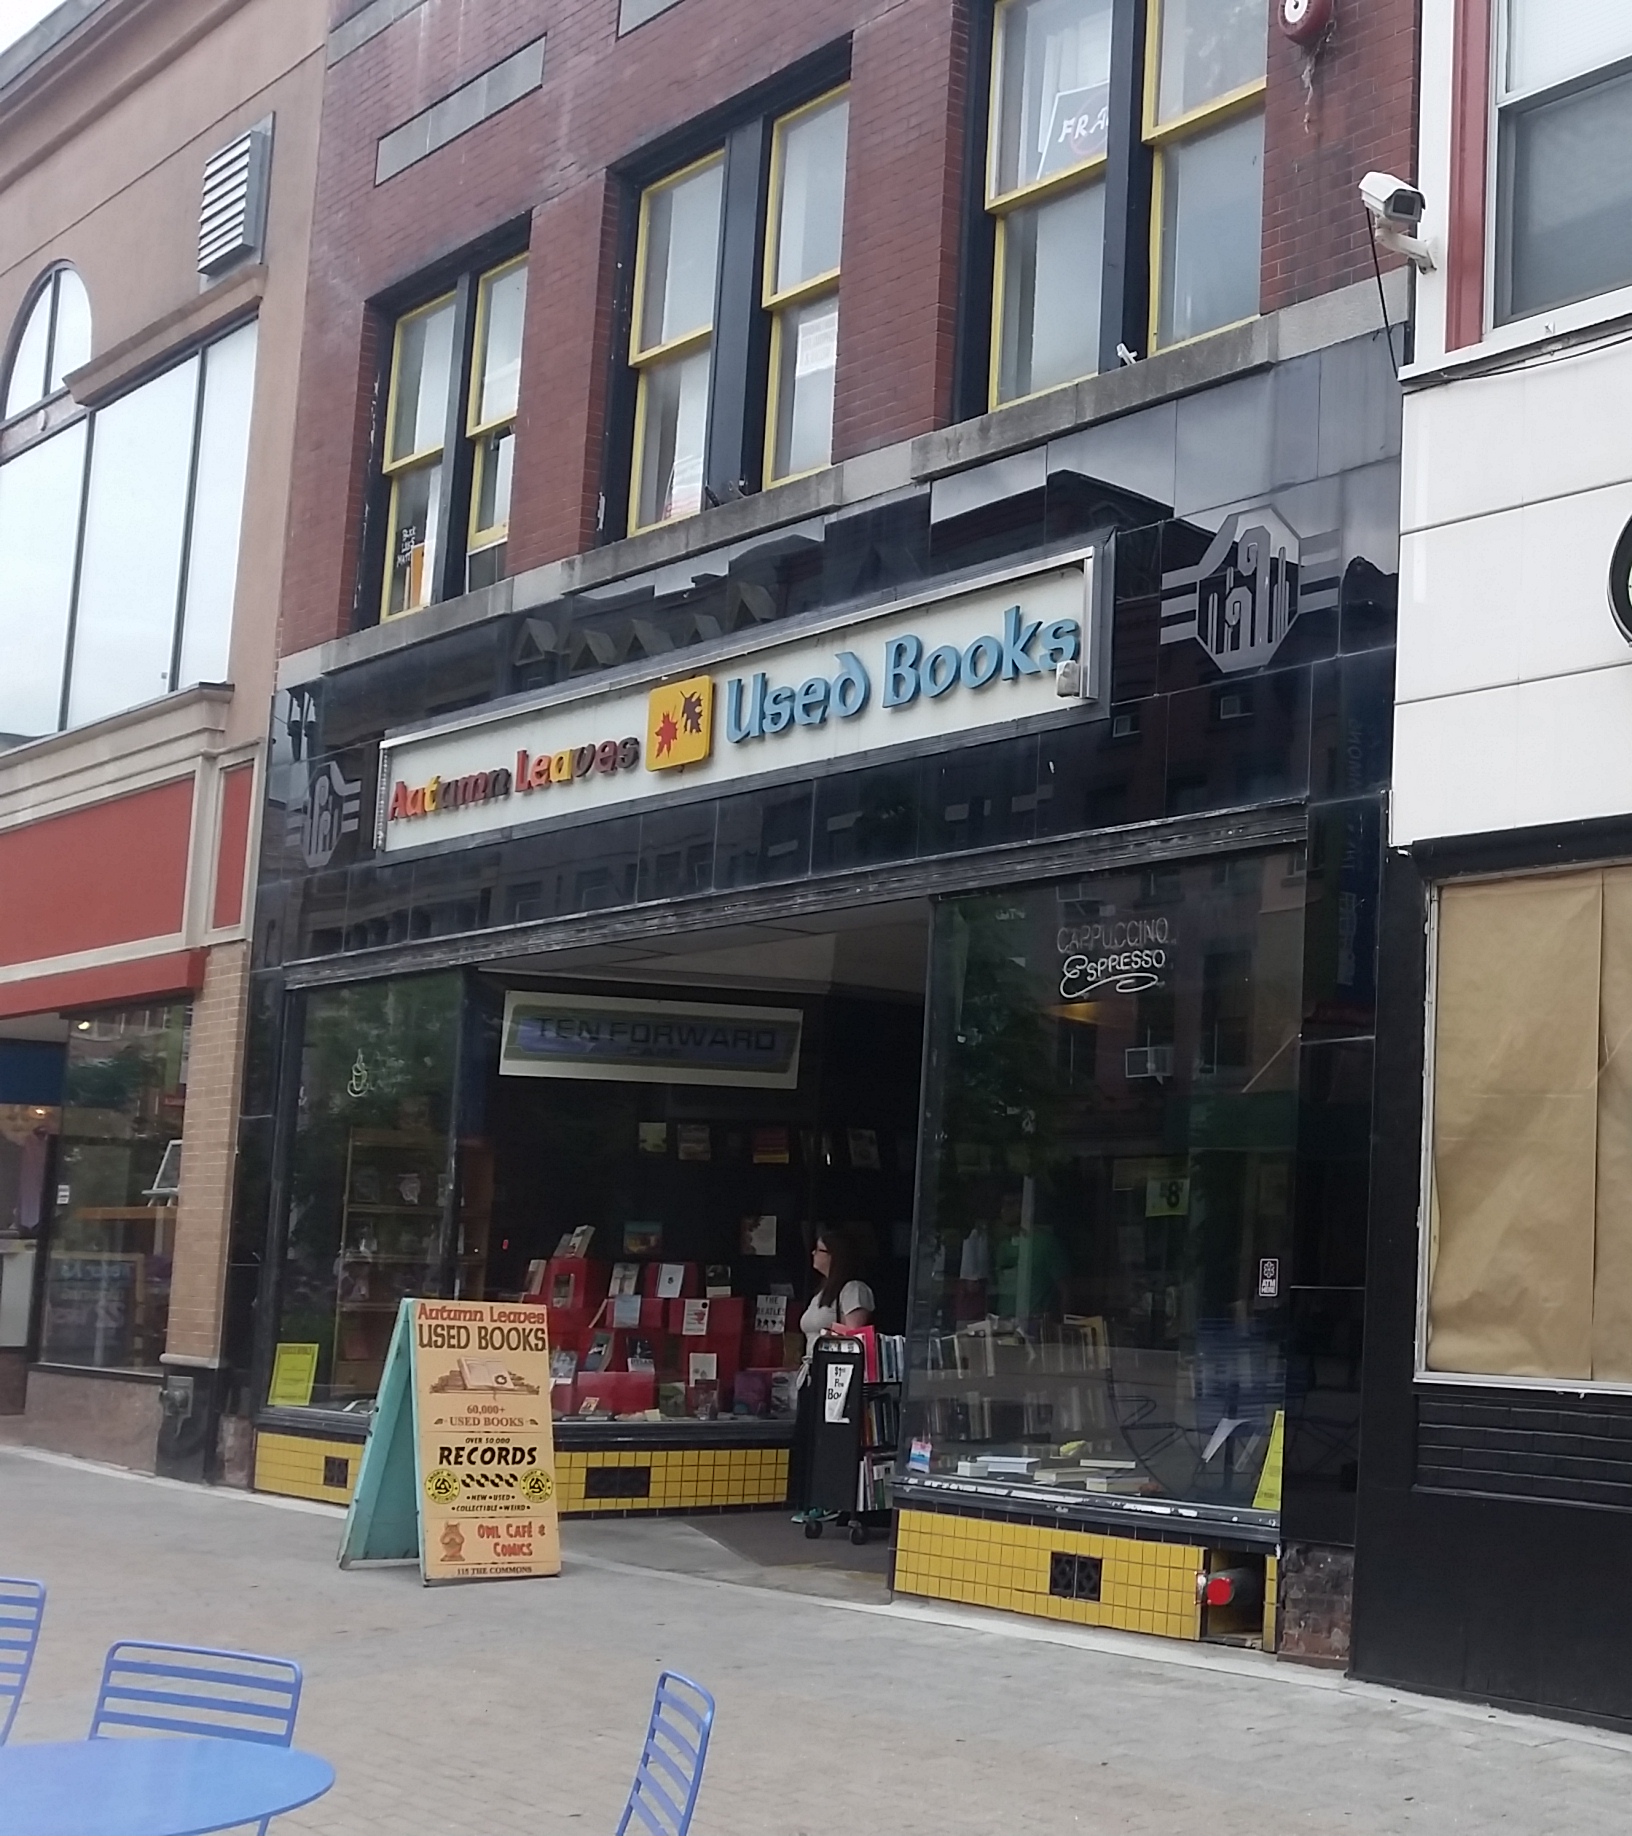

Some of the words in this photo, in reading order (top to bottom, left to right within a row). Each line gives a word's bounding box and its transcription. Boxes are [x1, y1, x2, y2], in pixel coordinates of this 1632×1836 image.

[388, 767, 512, 821] Autumn
[515, 737, 640, 792] Leaves
[726, 651, 871, 743] Used
[882, 605, 1080, 708] Books
[1057, 917, 1168, 953] CAPPUCCINO
[1060, 950, 1166, 990] ESPRESSO
[537, 1016, 600, 1040] TEN
[610, 1021, 776, 1050] FORWARD
[1262, 1279, 1276, 1287] ATM
[418, 1303, 484, 1322] Autumn
[489, 1306, 545, 1324] Leaves
[418, 1324, 471, 1349] USED
[478, 1326, 546, 1351] BOOKS
[450, 1417, 480, 1426] USED
[484, 1417, 524, 1427] BOOKS
[439, 1446, 538, 1466] RECORDS
[477, 1524, 501, 1539] OWL
[493, 1542, 533, 1557] COMICS
[472, 1567, 488, 1575] THE
[490, 1566, 532, 1574] COMMONS
